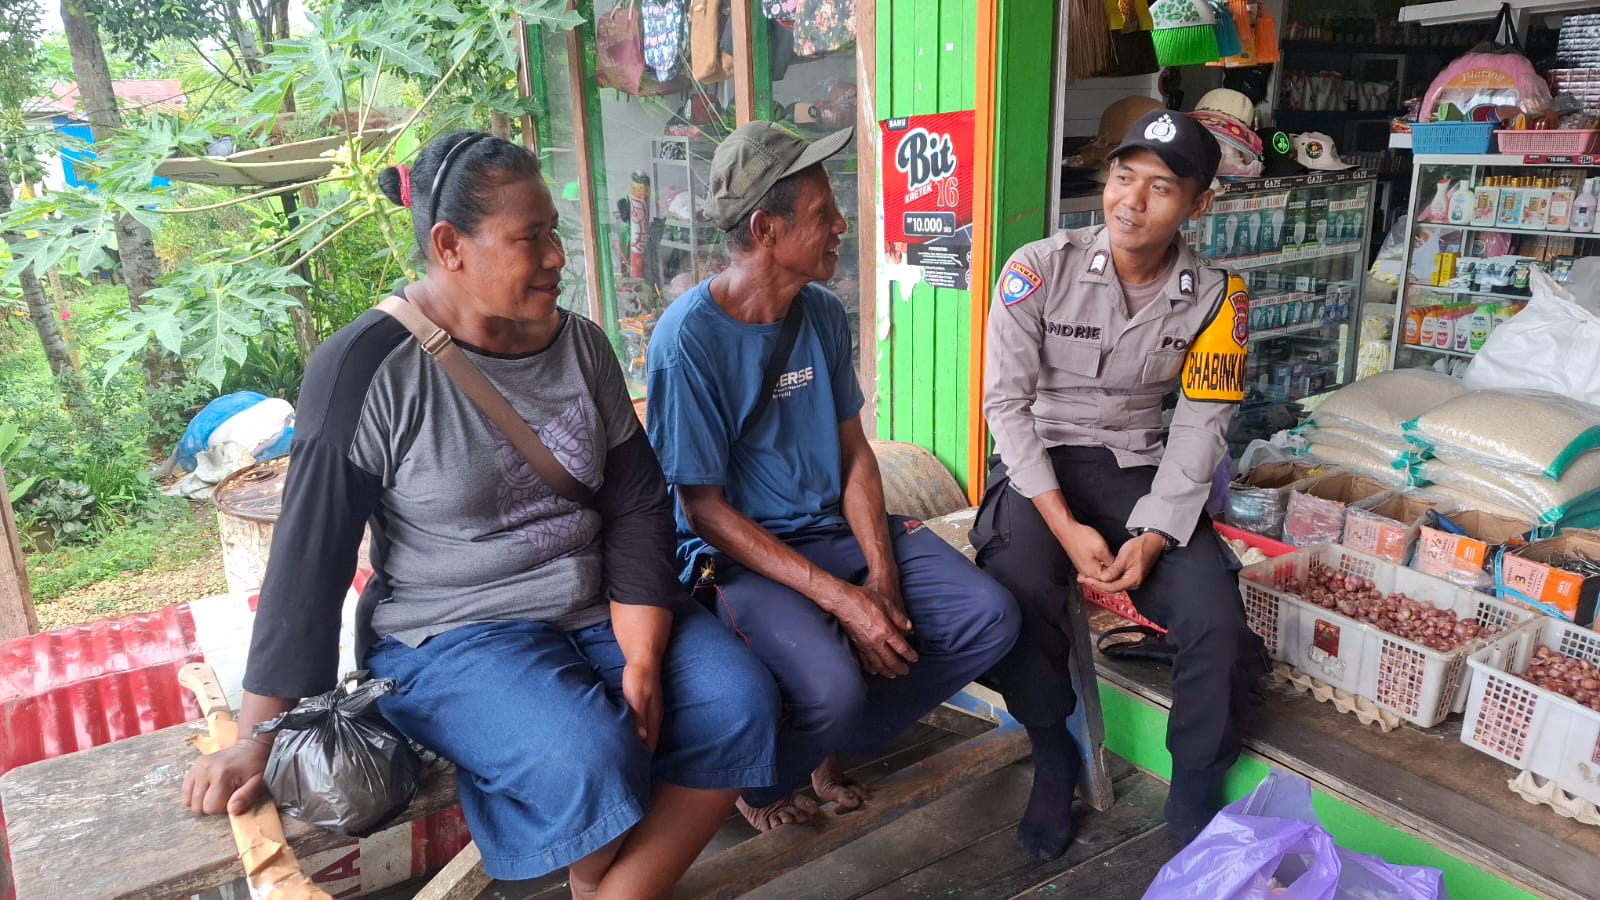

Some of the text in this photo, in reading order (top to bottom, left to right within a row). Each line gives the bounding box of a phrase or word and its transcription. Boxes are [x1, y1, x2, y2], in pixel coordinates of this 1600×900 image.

[896, 129, 956, 190] Bit
[1264, 179, 1281, 188] GAZE
[1307, 175, 1323, 184] GAZE
[1352, 170, 1368, 179] GAZE
[904, 182, 933, 205] KRETEK
[935, 177, 960, 208] 16
[912, 217, 943, 232] 10.000
[776, 366, 814, 388] ERSE
